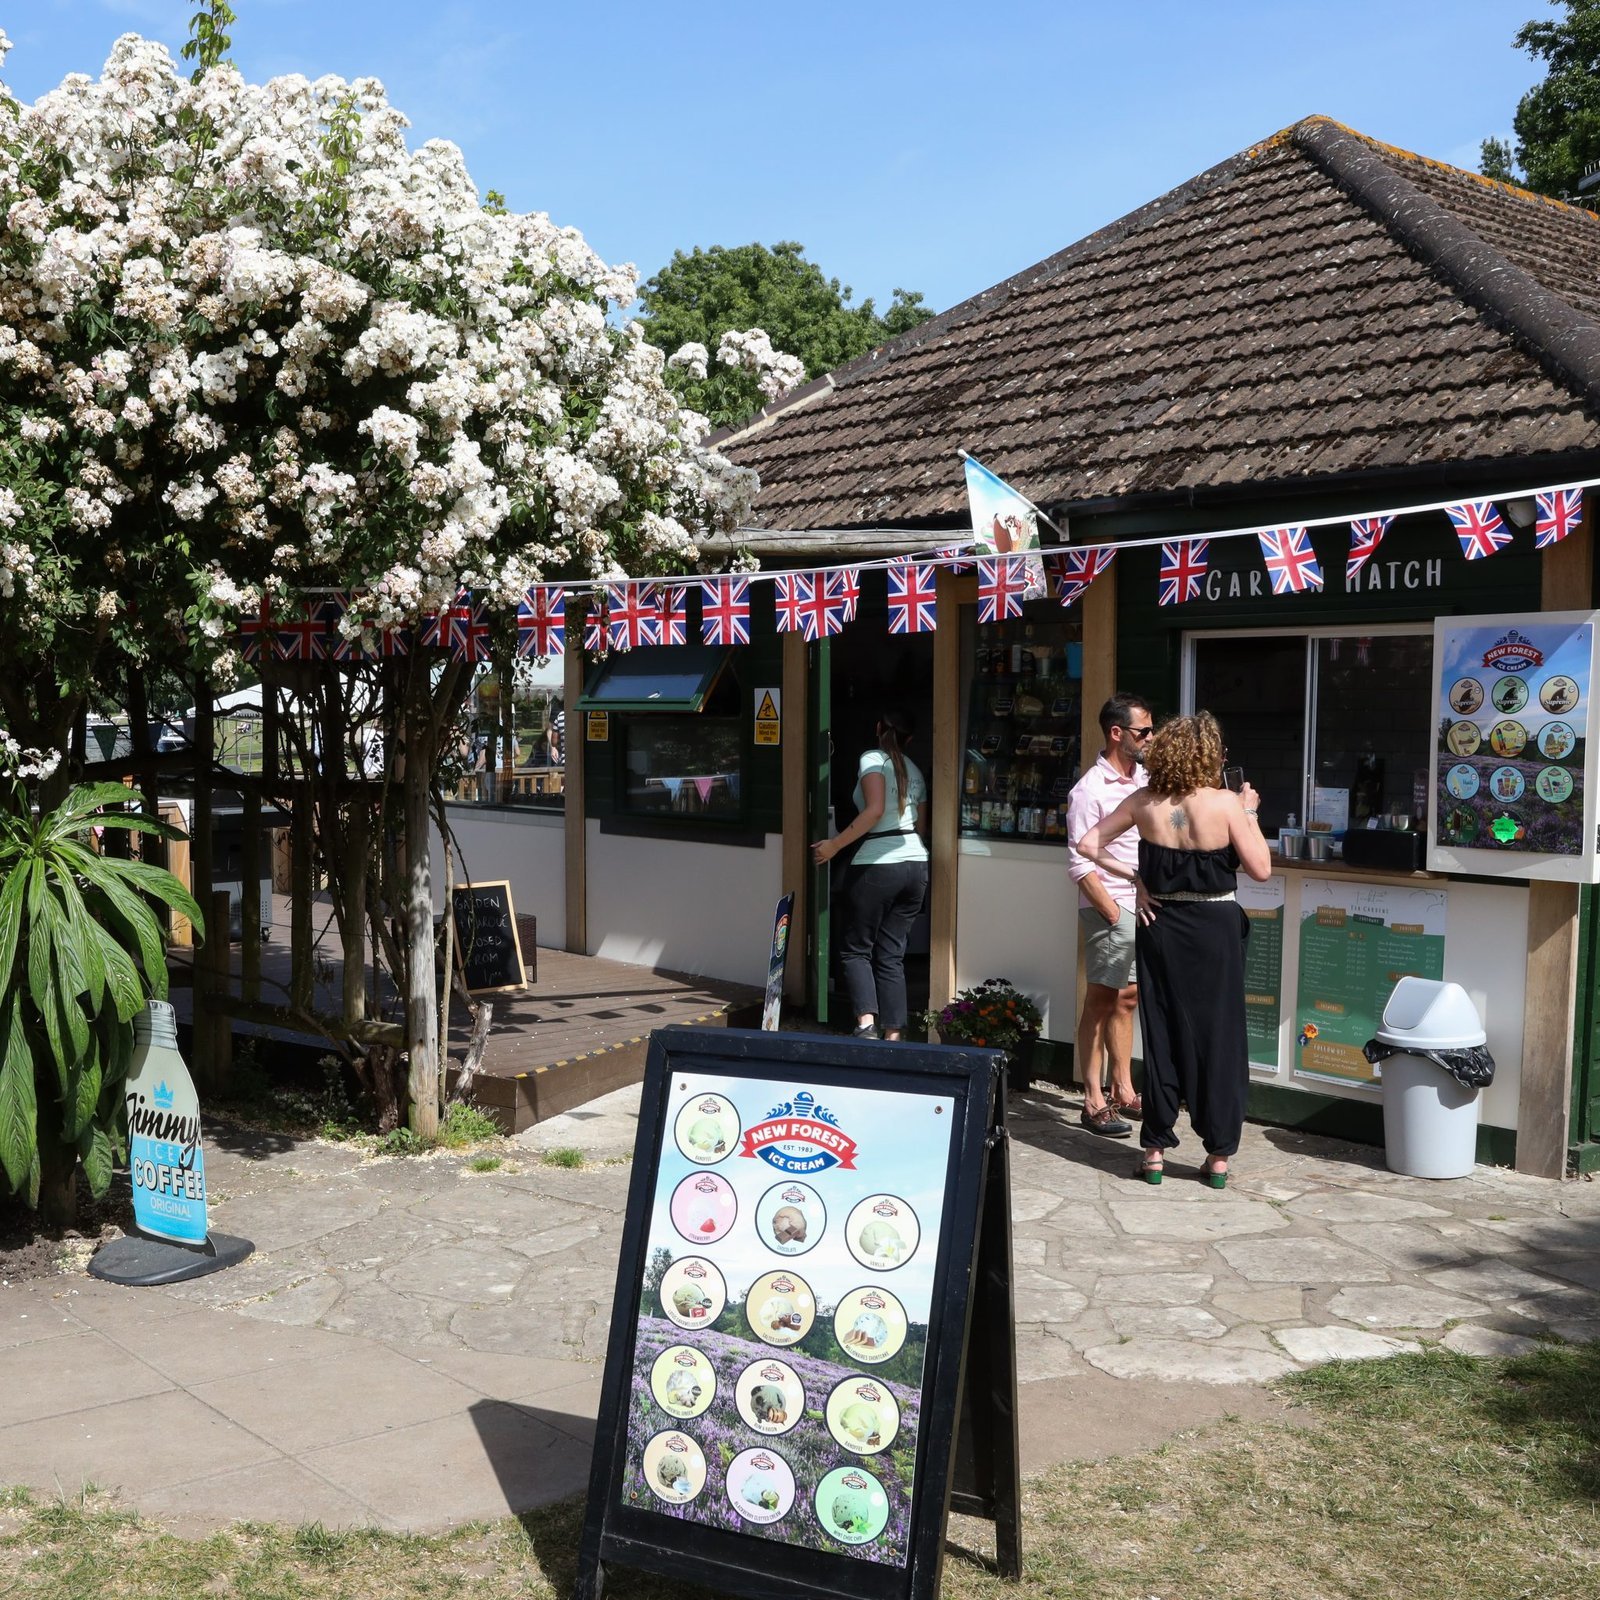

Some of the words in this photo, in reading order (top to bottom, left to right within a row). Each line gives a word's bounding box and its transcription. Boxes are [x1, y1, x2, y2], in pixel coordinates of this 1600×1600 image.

[1205, 565, 1324, 601] GARN
[1345, 558, 1442, 594] HATCH
[1487, 647, 1506, 660] NEW
[1507, 646, 1539, 659] FOREST
[1496, 662, 1506, 670] ICE
[1506, 662, 1527, 671] CREAM
[462, 935, 502, 949] COSED
[750, 1124, 788, 1145] NEW
[791, 1123, 850, 1153] FOREST
[783, 1144, 796, 1152] EST.
[798, 1145, 814, 1154] 1983
[767, 1152, 786, 1167] ICE
[787, 1157, 826, 1171] CREAM
[132, 1156, 204, 1201] COFFEE
[150, 1197, 193, 1218] ORIGINAL
